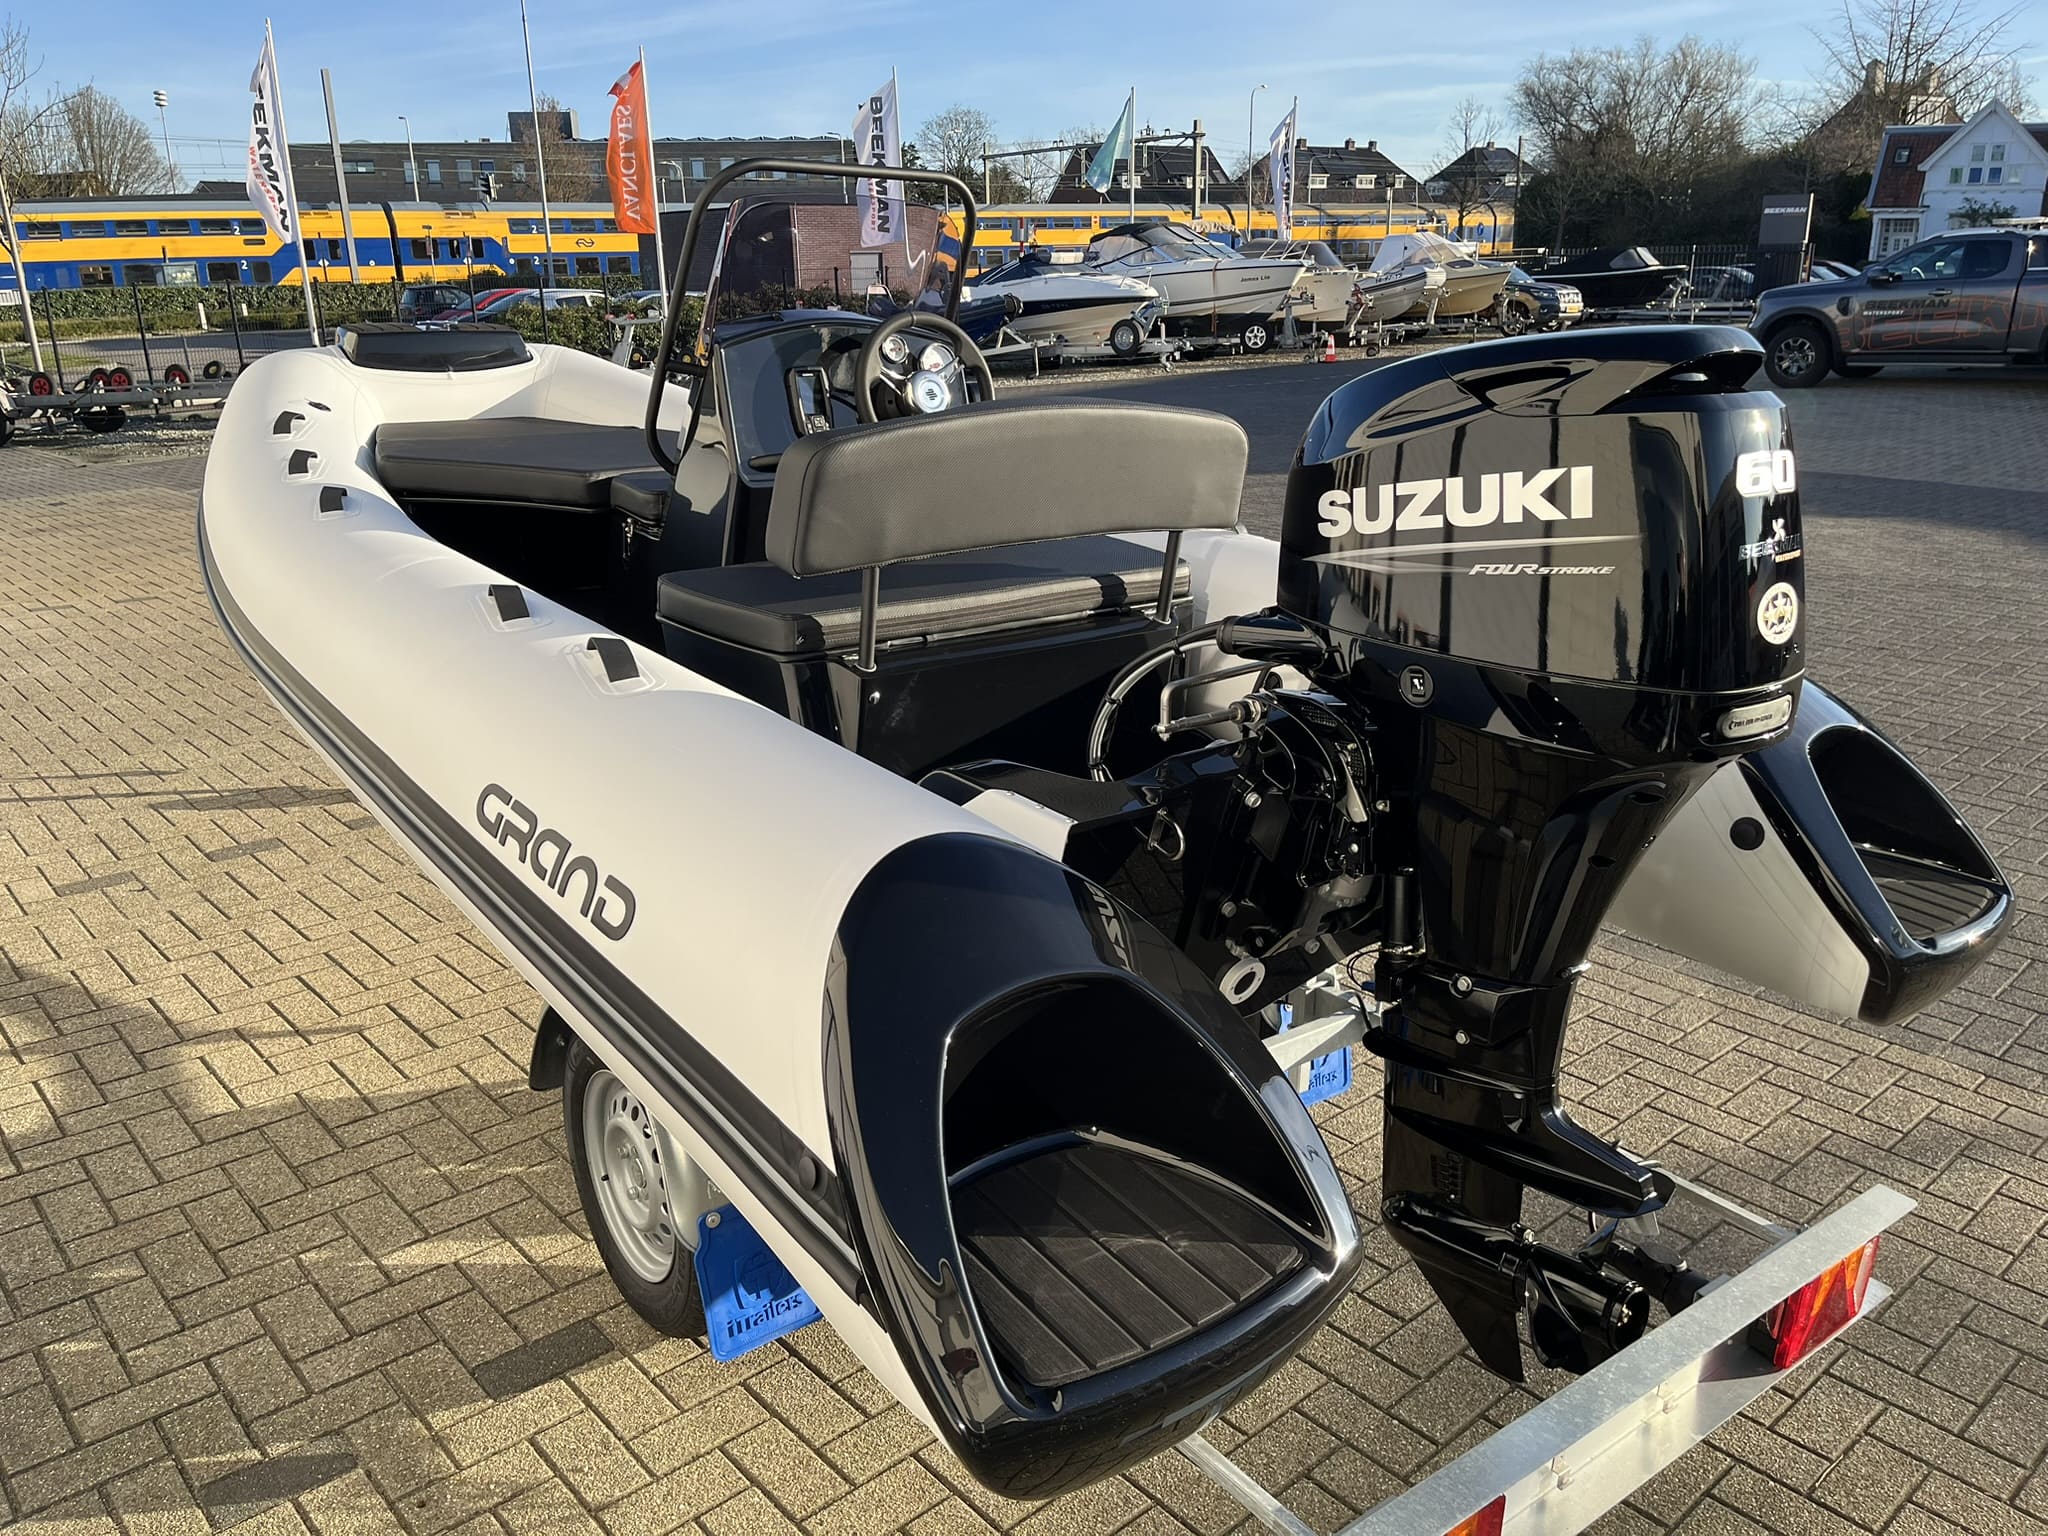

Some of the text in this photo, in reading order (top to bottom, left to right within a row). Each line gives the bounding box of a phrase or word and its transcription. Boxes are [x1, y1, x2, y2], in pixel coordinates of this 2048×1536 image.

[869, 96, 890, 233] BEEKMAN
[233, 225, 241, 235] 2
[531, 225, 538, 234] 2
[240, 259, 249, 270] 2
[533, 256, 540, 265] 2
[1863, 298, 1950, 310] BEEKMAN
[1736, 449, 1796, 498] 60
[1317, 465, 1593, 538] SUZUKI
[476, 783, 637, 942] GRAND
